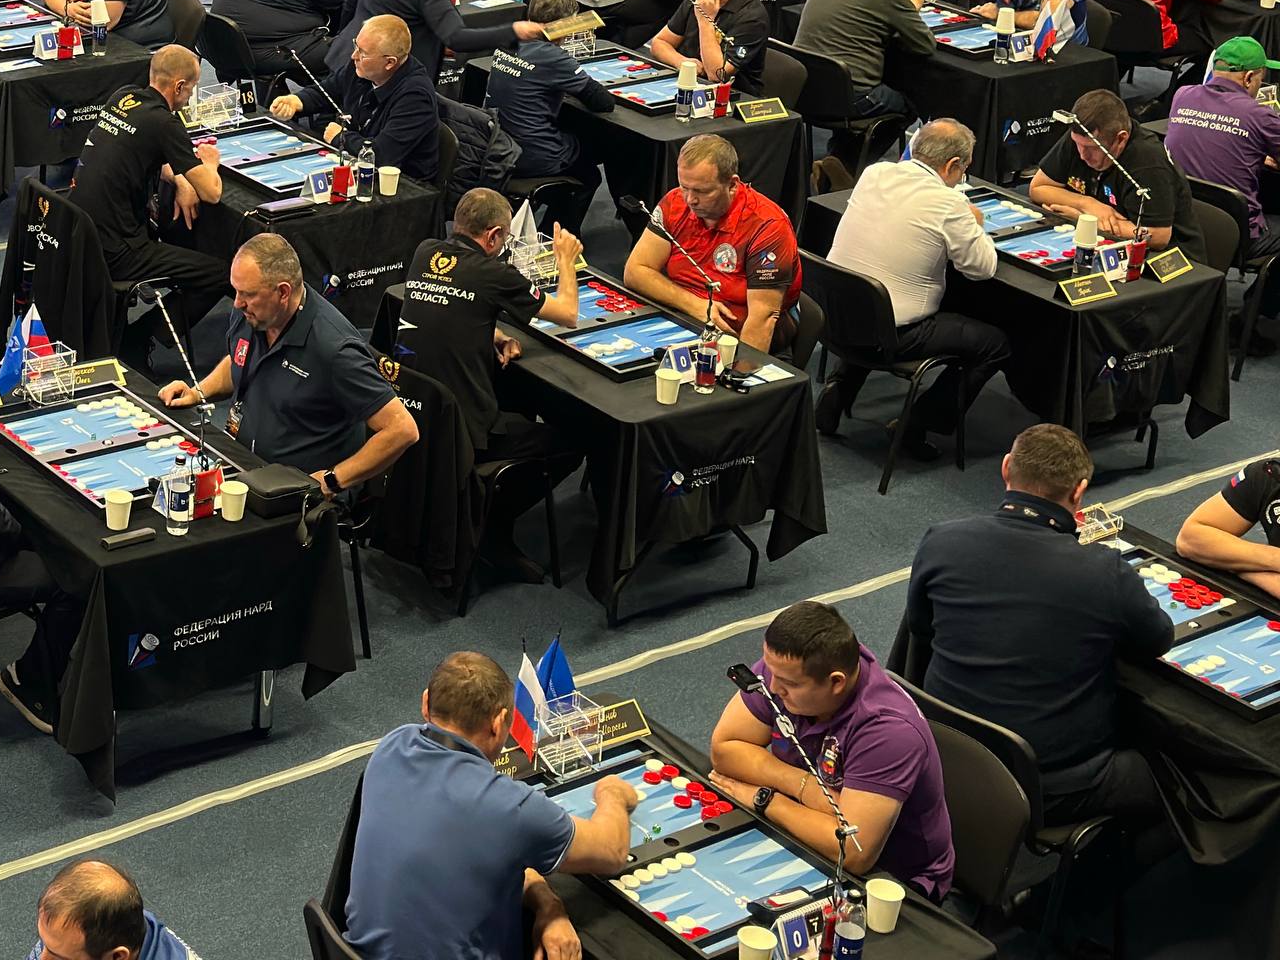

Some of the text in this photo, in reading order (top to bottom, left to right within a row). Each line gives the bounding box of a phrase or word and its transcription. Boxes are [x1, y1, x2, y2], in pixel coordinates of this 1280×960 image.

[47, 38, 53, 48] 0
[241, 90, 254, 105] 18
[697, 96, 703, 106] 0
[1177, 107, 1240, 127] ФЕДЕРАЦИЯ НАРД
[1210, 122, 1249, 138] ОБЛАСТИ
[318, 179, 324, 190] 0
[1109, 255, 1115, 267] 0
[410, 291, 449, 305] ОБЛАСТЬ
[680, 356, 687, 368] 0
[734, 455, 755, 466] НАРД
[173, 600, 273, 637] ФЕДЕРАЦИЯ НАРД
[173, 629, 220, 651] РОССИИ
[813, 921, 819, 934] 7
[793, 930, 803, 949] 0
